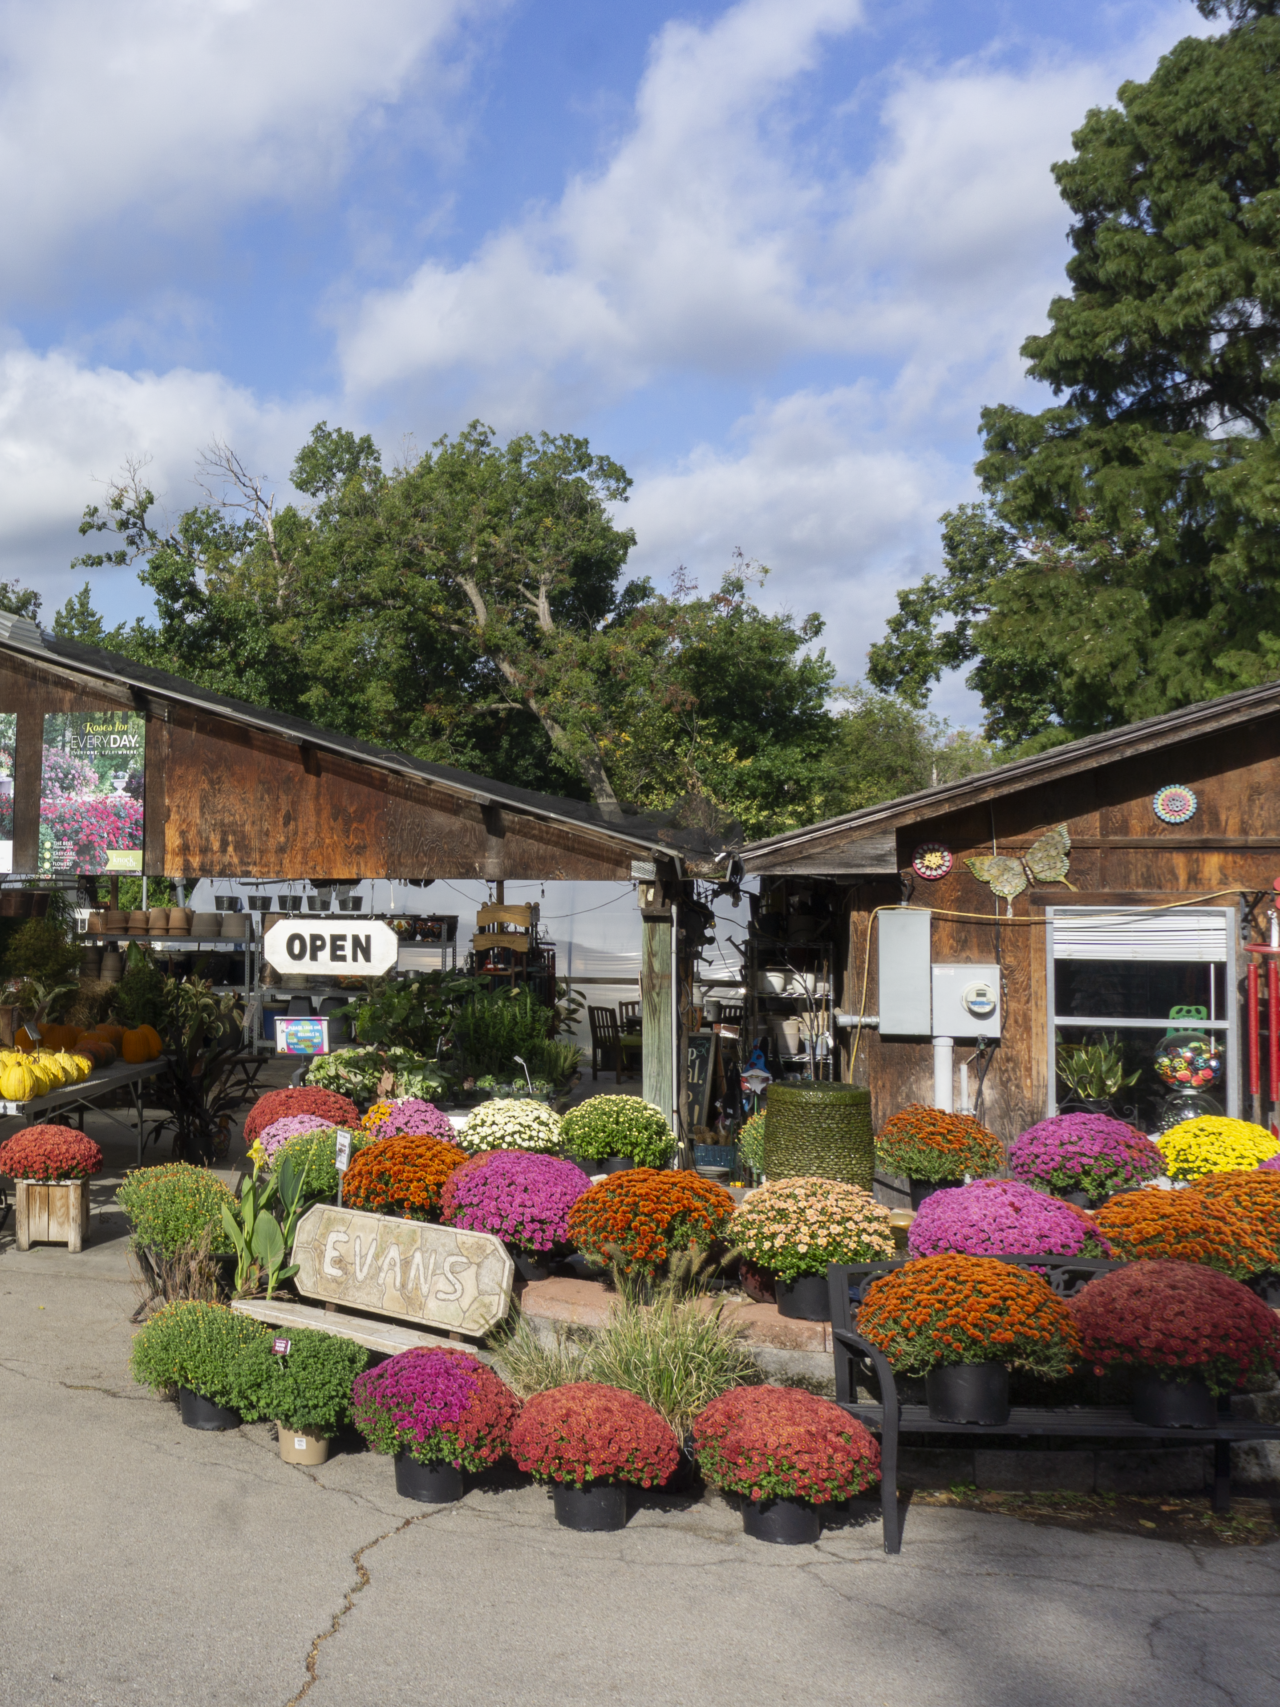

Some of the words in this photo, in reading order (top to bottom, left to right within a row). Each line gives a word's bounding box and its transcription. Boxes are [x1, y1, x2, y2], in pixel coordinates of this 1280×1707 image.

[82, 722, 112, 734] Roses
[286, 932, 372, 962] OPEN
[323, 1230, 470, 1300] EVANS
